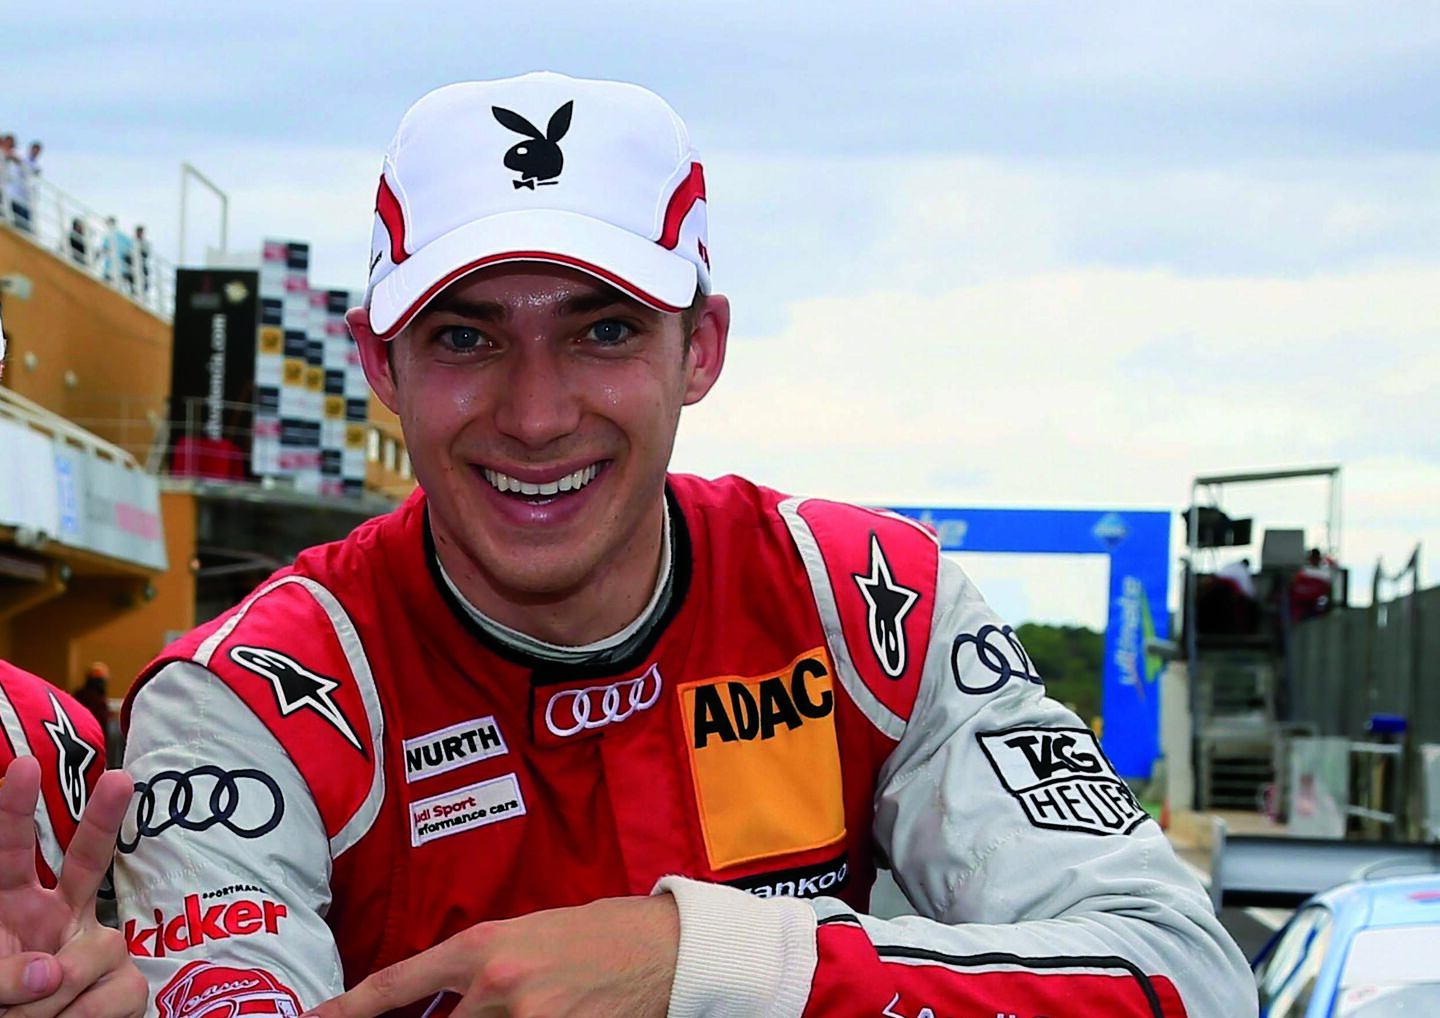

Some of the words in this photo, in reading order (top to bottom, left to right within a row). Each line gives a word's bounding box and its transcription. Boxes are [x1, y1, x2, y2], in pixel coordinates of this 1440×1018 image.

[694, 658, 833, 749] ADAC
[1004, 734, 1103, 780] TAG
[414, 809, 431, 827] udi
[432, 797, 477, 817] Sport
[418, 808, 487, 836] rformance
[490, 800, 519, 814] cars
[744, 863, 848, 898] ankoo
[125, 894, 287, 958] kicker
